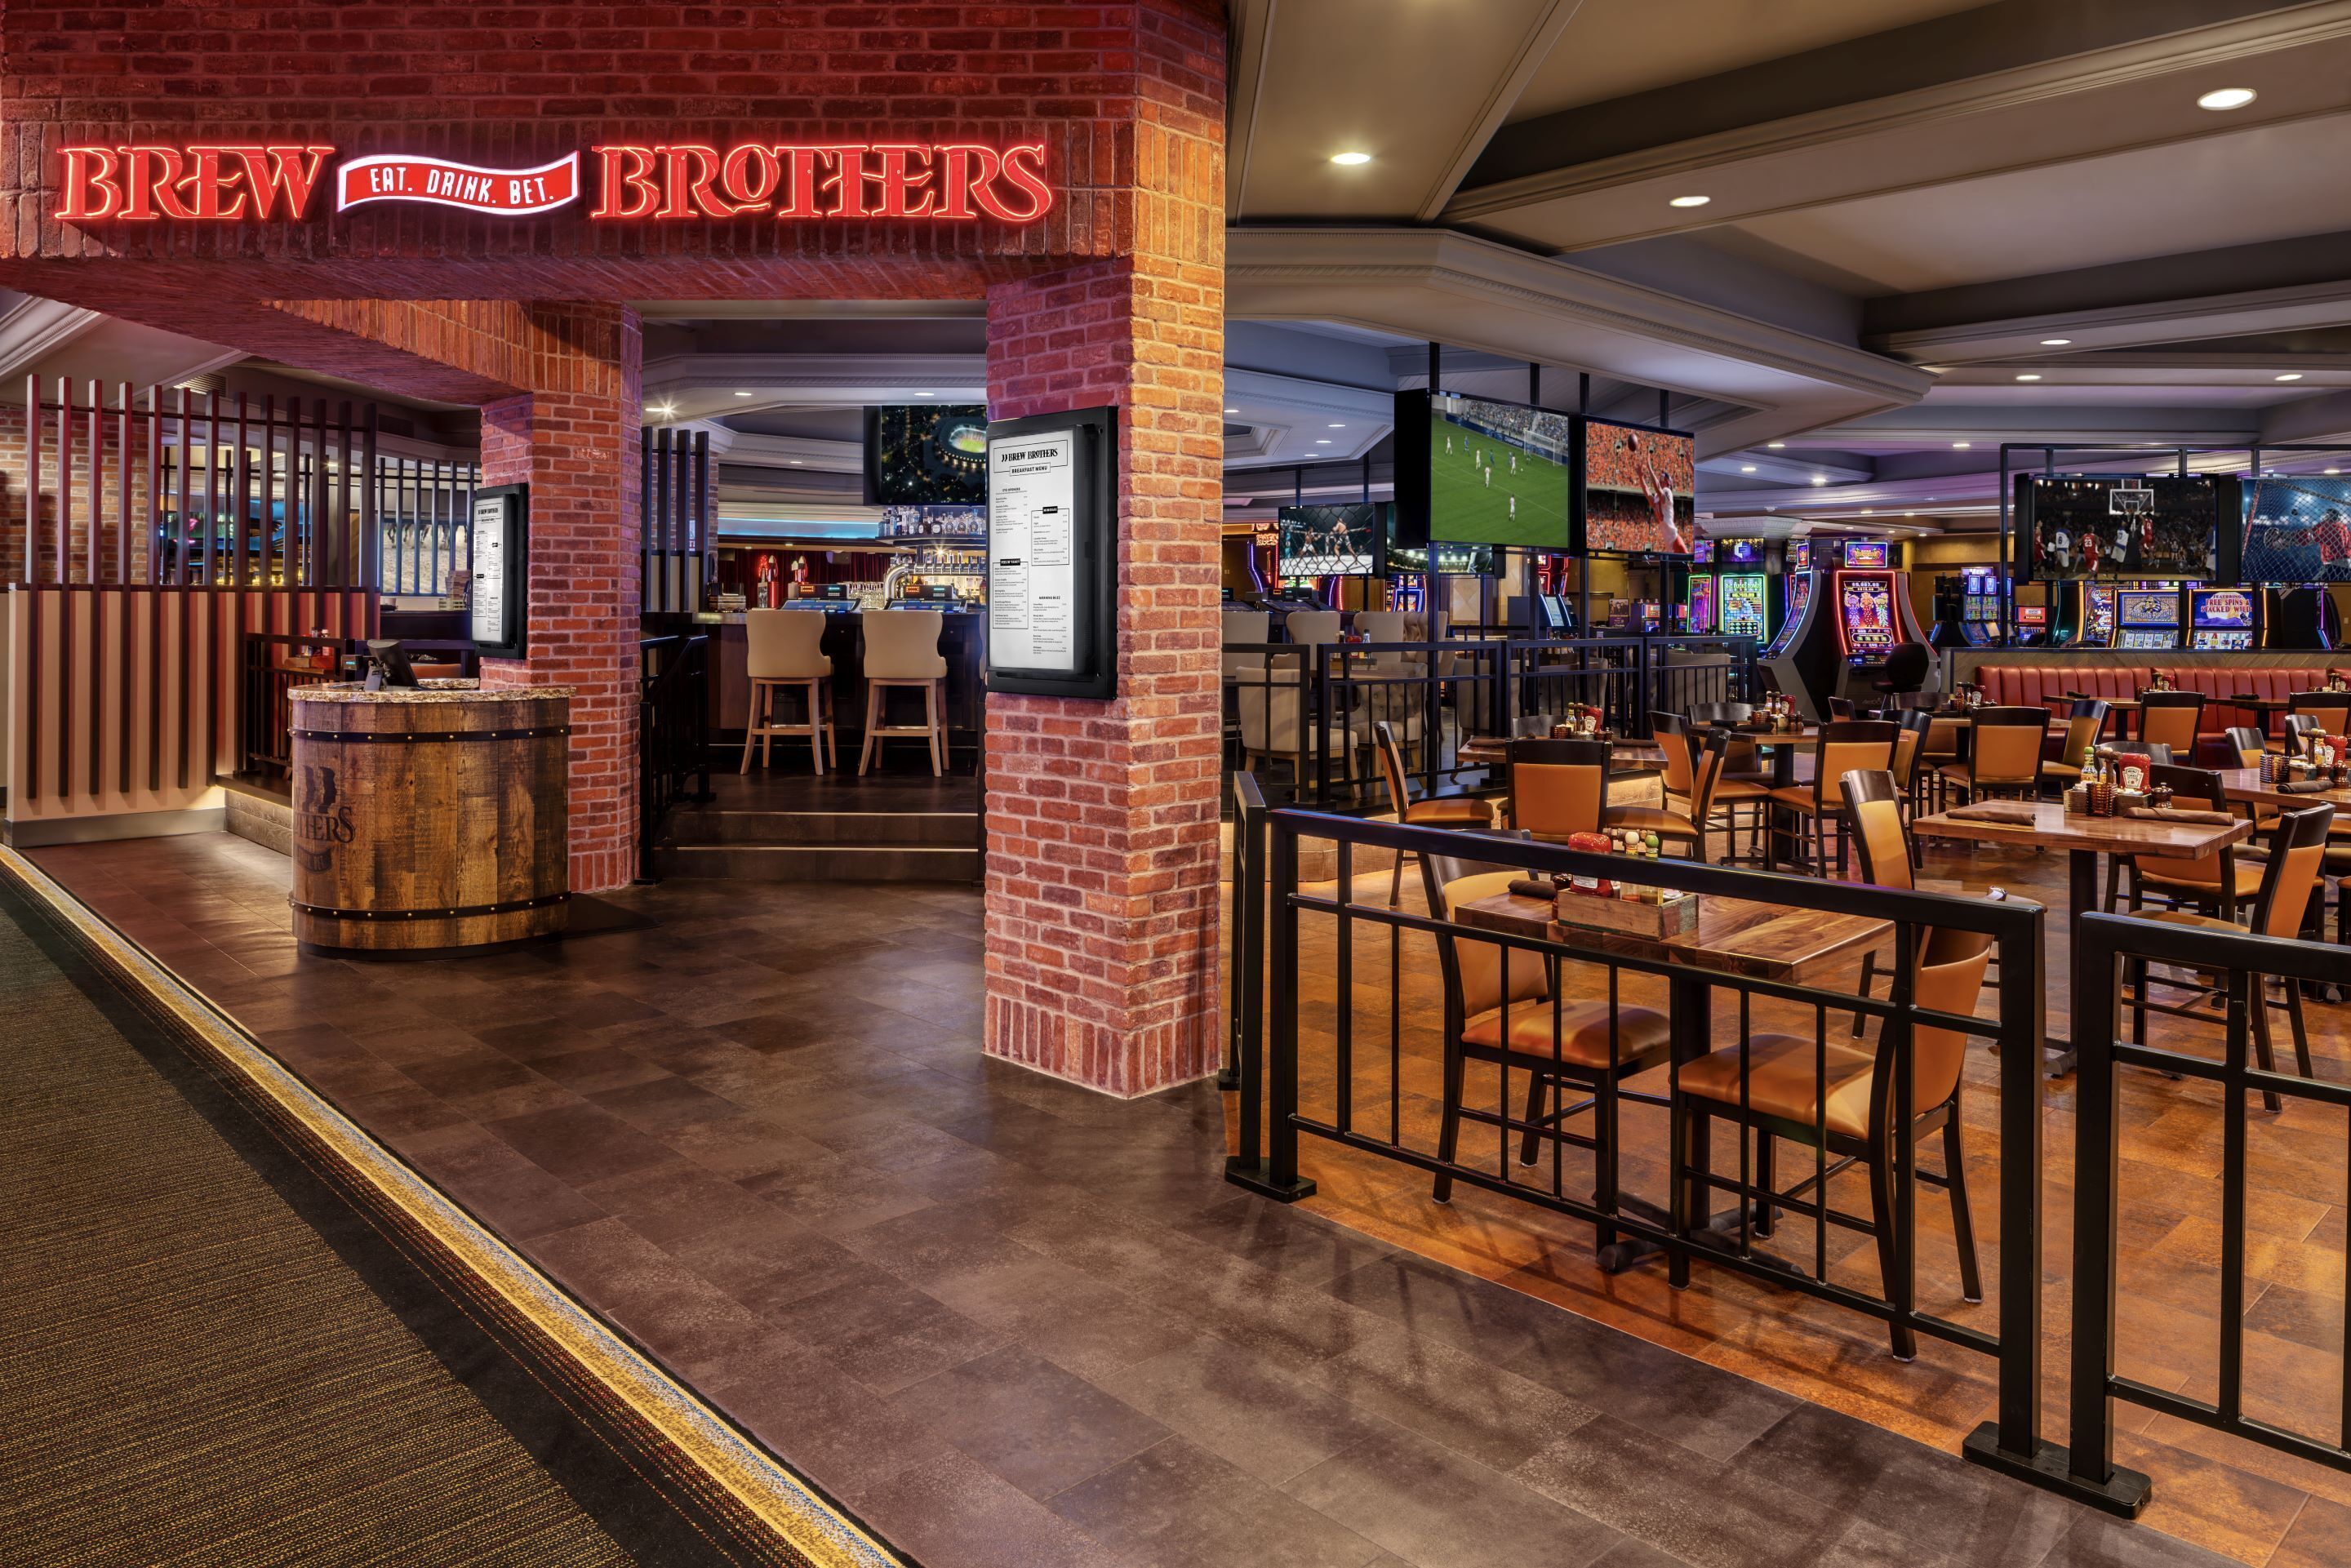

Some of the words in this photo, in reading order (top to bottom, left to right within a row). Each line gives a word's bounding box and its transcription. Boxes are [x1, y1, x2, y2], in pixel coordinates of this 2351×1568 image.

[54, 145, 336, 221] BREW
[370, 168, 412, 193] EAT.
[426, 168, 496, 205] DRINK.
[509, 179, 555, 206] BET.
[591, 144, 1053, 221] BROTHERS
[1008, 451, 1026, 462] BREW
[1028, 448, 1058, 460] BROTHERS
